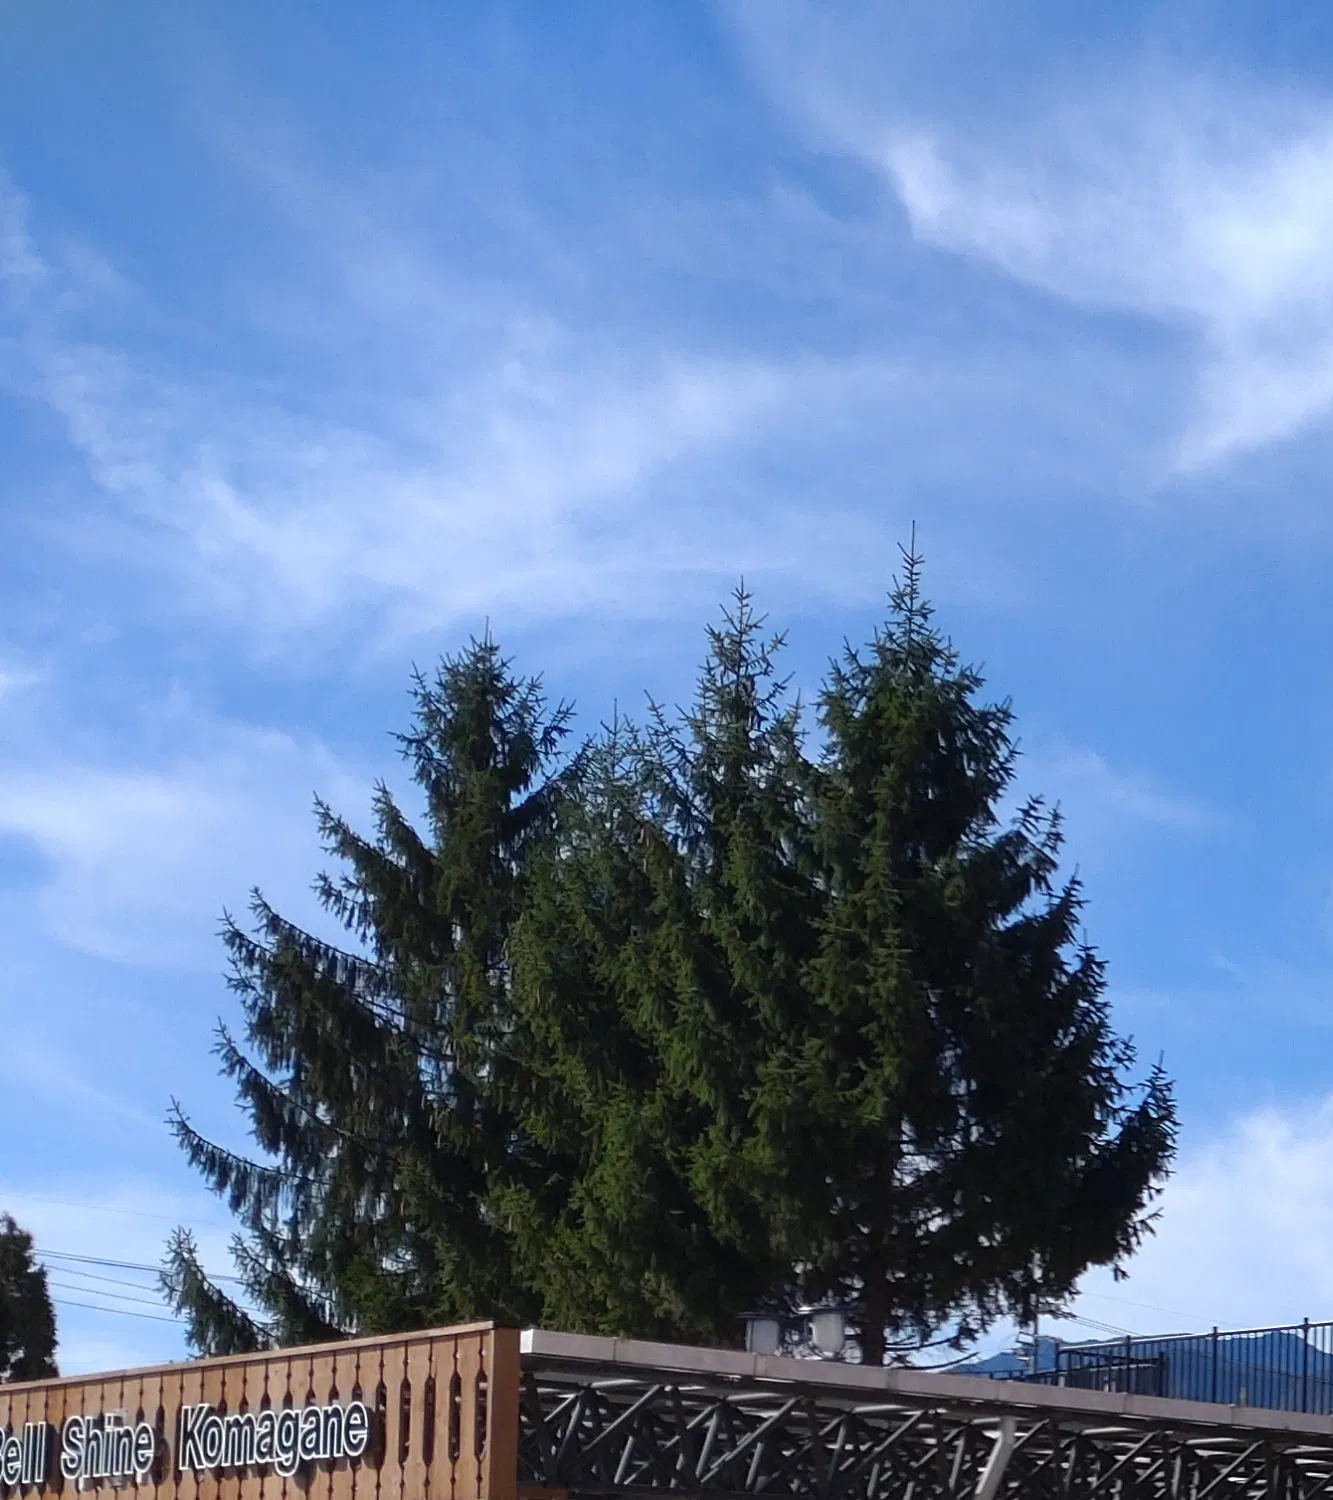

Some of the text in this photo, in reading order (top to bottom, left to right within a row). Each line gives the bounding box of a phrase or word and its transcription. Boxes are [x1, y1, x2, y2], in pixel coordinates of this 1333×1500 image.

[0, 1401, 368, 1486] ell Shine Komagane
